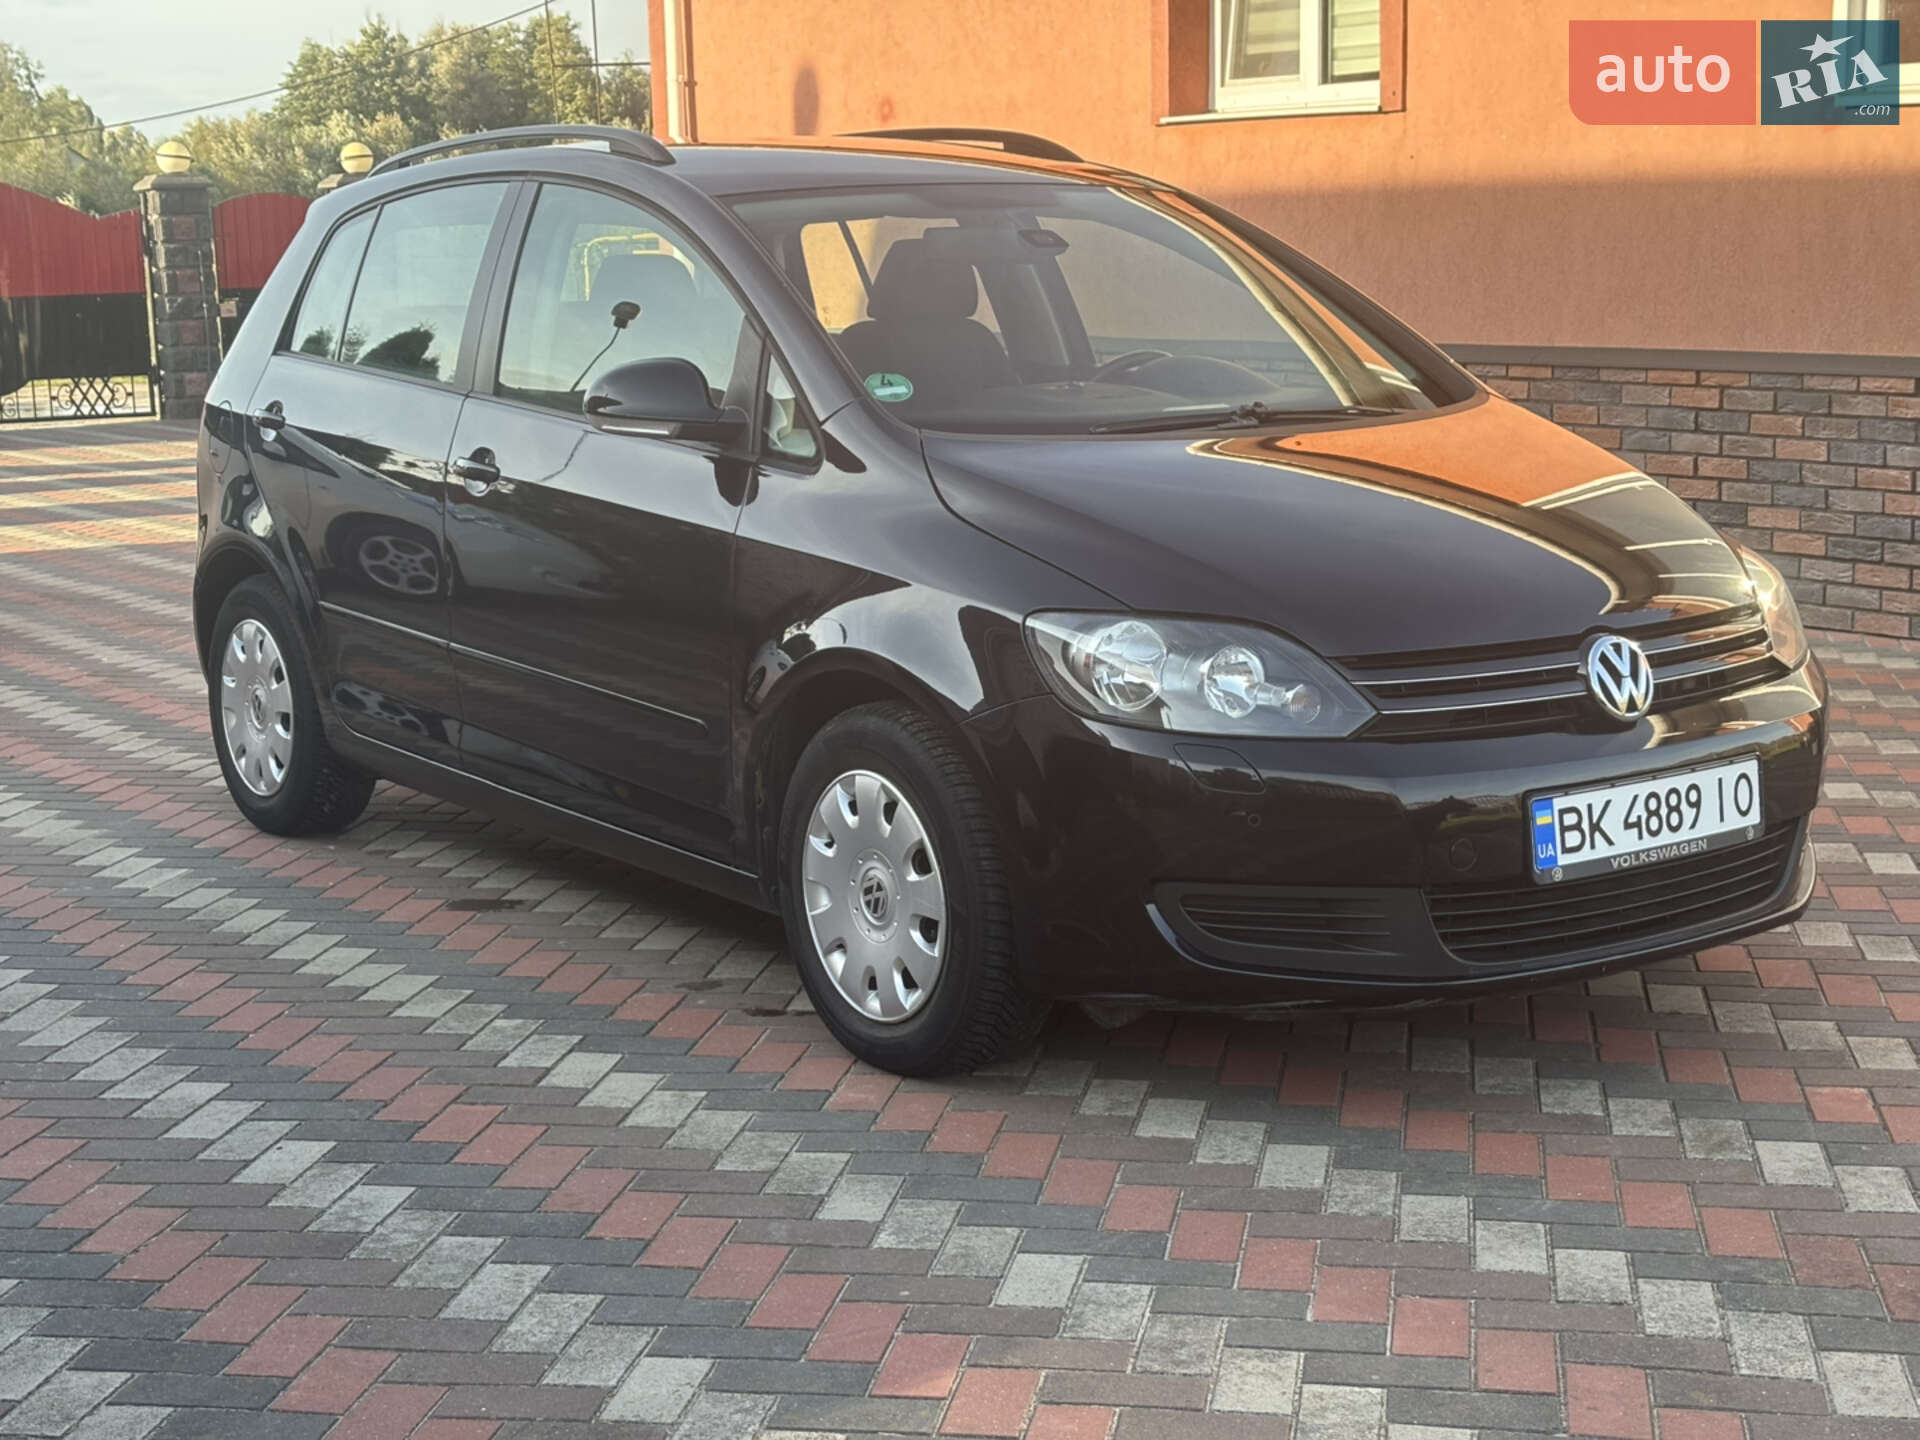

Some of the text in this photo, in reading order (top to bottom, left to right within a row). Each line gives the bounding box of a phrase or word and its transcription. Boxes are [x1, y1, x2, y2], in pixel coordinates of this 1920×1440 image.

[1558, 799, 1615, 855] BK
[1623, 783, 1702, 840] 4889
[1538, 843, 1555, 859] UA
[1610, 838, 1708, 869] VOLKSWAGEN
